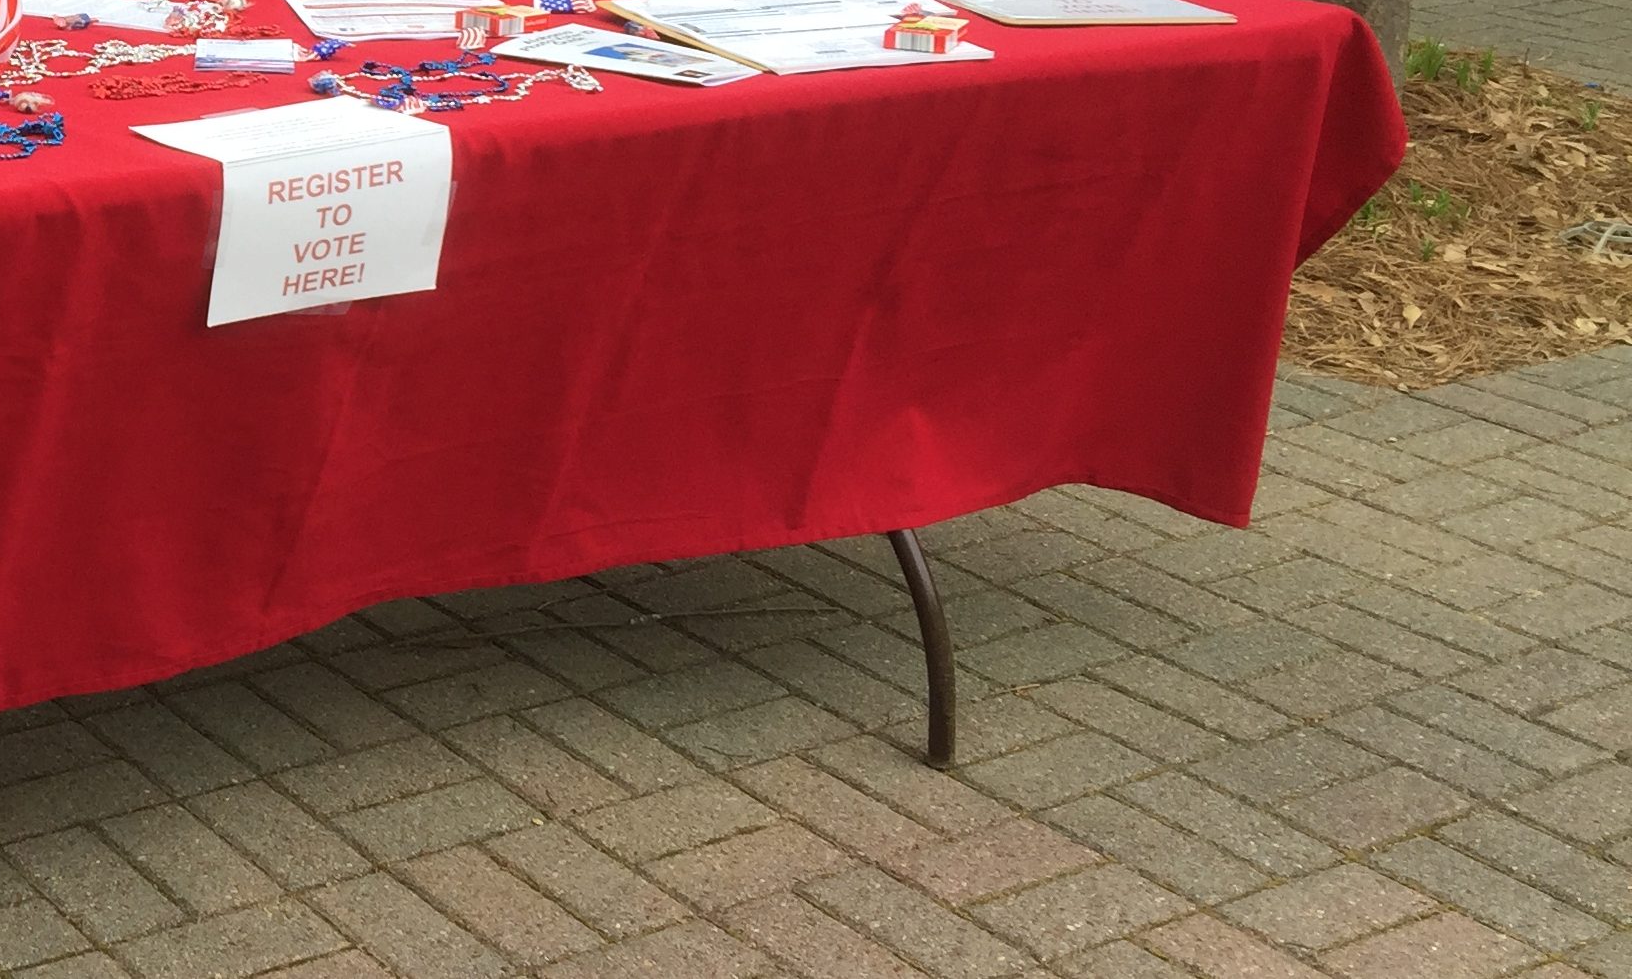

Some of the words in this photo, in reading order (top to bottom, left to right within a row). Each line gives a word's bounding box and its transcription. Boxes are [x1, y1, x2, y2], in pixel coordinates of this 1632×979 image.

[268, 160, 404, 204] REGISTER
[316, 204, 352, 228] TO
[294, 232, 366, 263] VOTE
[282, 263, 365, 296] HERE!
